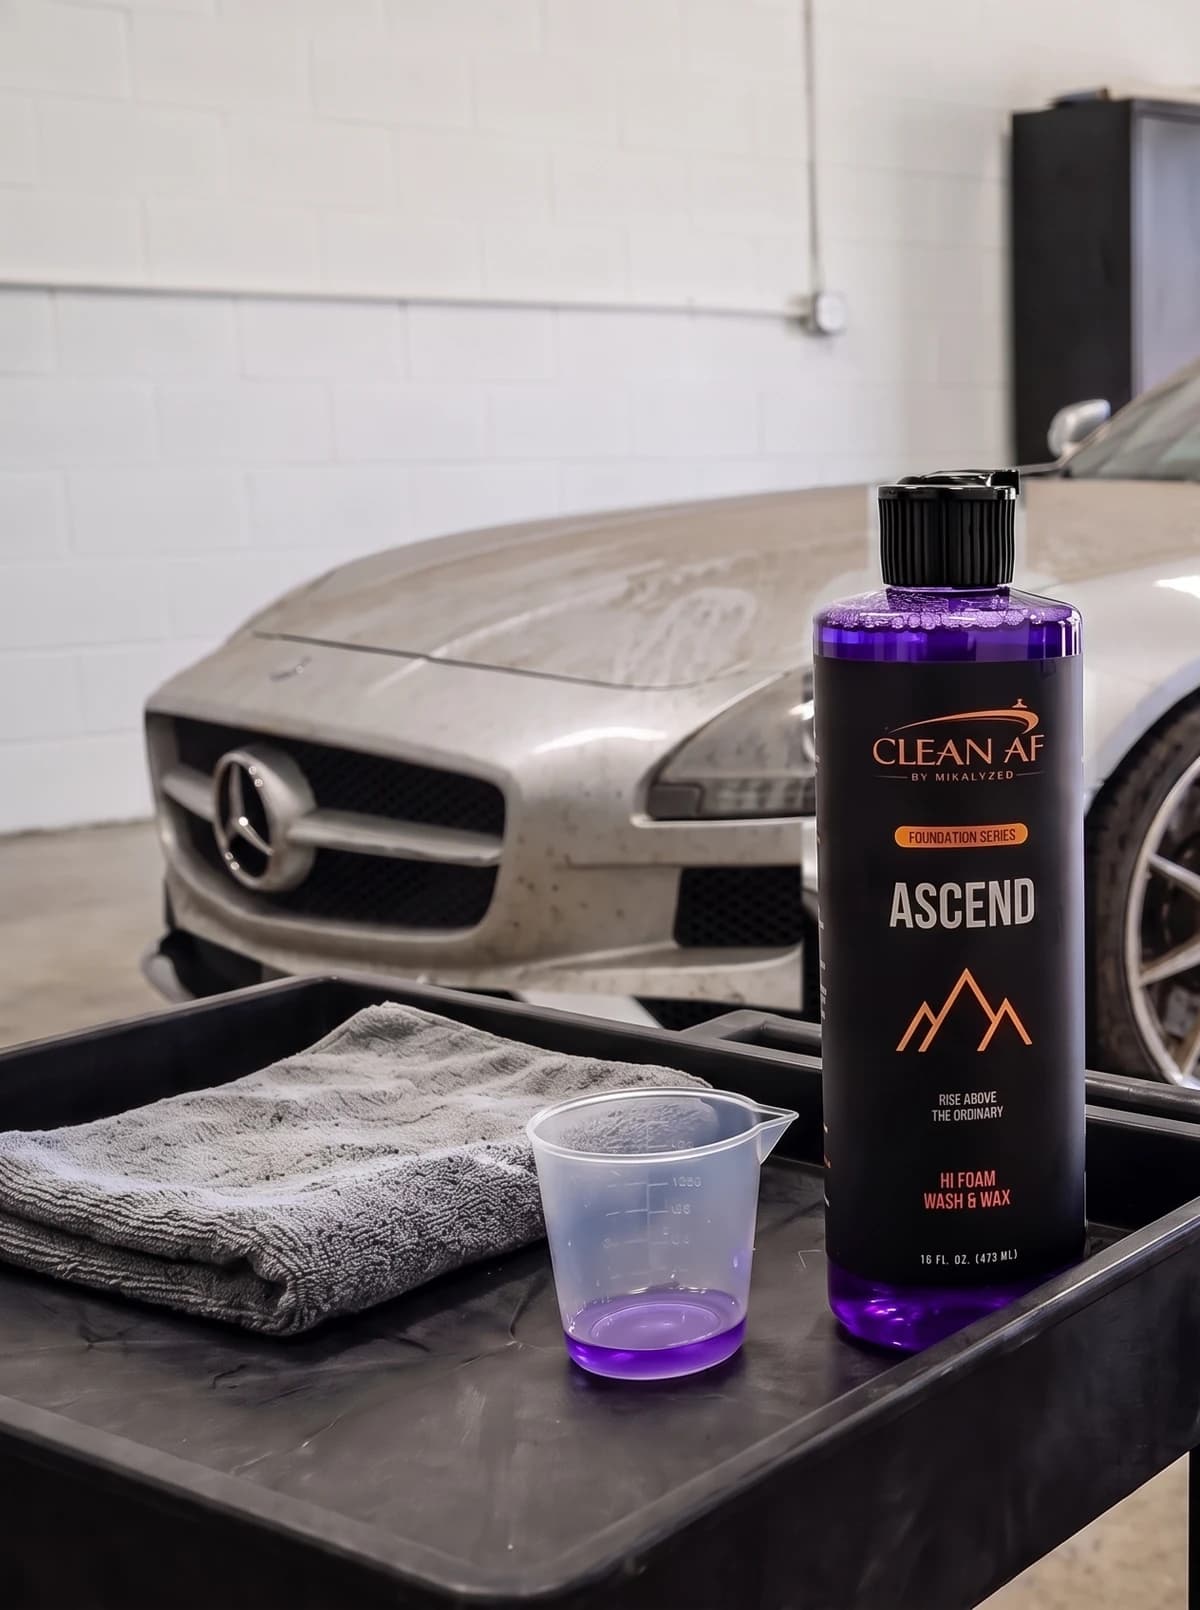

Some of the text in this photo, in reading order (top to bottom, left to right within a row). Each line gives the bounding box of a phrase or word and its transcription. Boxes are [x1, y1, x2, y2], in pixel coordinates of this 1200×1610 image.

[872, 733, 1046, 766] CLEAN AF
[911, 770, 1014, 782] BY MIKALYZED
[909, 828, 1016, 845] FOUNDATION SERIES
[889, 877, 1035, 930] ASCEND
[938, 1090, 997, 1106] RISE ABOVE
[932, 1105, 1004, 1122] THE ORDINARY
[940, 1170, 996, 1189] HI FOAM
[923, 1188, 1012, 1210] WASH & WAX
[920, 1248, 1018, 1266] 16 FL. OZ. (473 ML)
